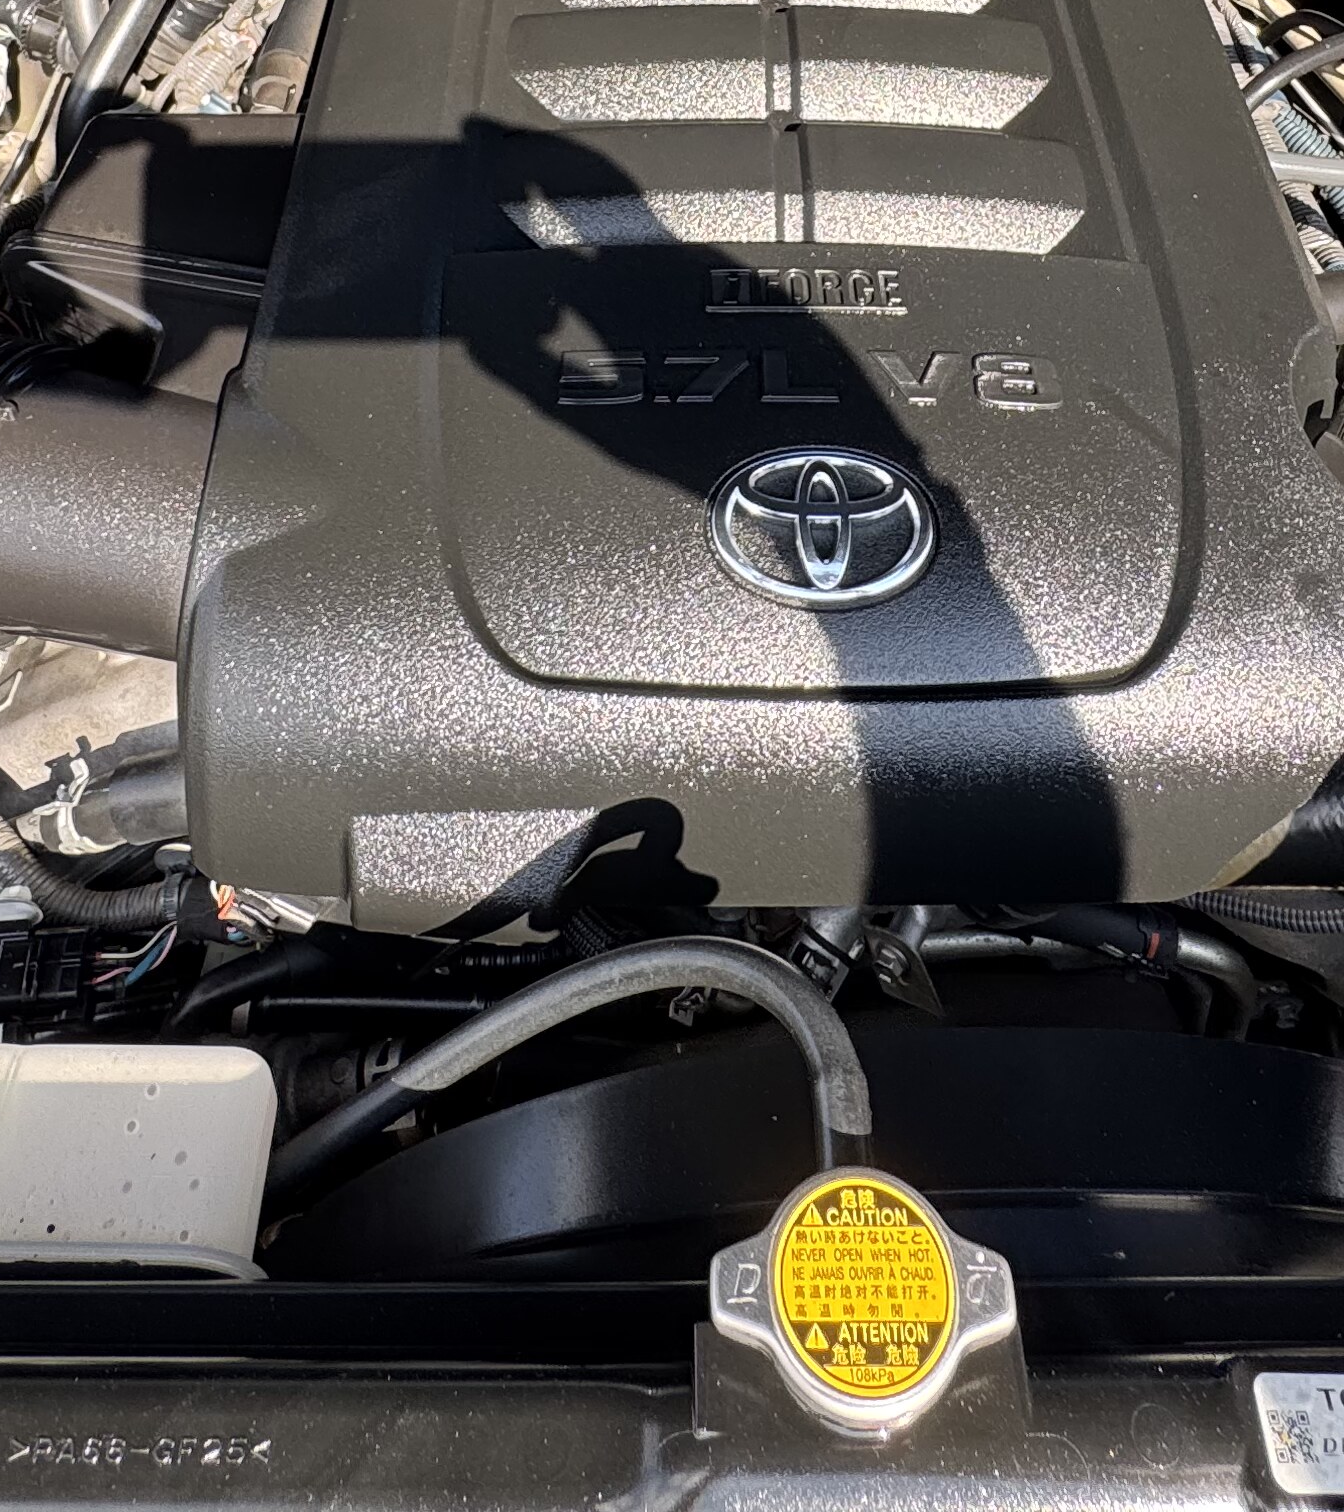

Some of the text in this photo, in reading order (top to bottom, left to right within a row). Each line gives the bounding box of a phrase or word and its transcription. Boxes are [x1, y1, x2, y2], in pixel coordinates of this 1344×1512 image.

[867, 349, 1063, 410] V8
[826, 1206, 909, 1227] CAUTION
[791, 1248, 935, 1263] NEVER OPEN WHEN HOT.
[792, 1262, 936, 1282] NE JAMAIS OUVRIR À CHAUD.
[838, 1321, 930, 1344] ATTENTION
[849, 1367, 896, 1384] 108kPa
